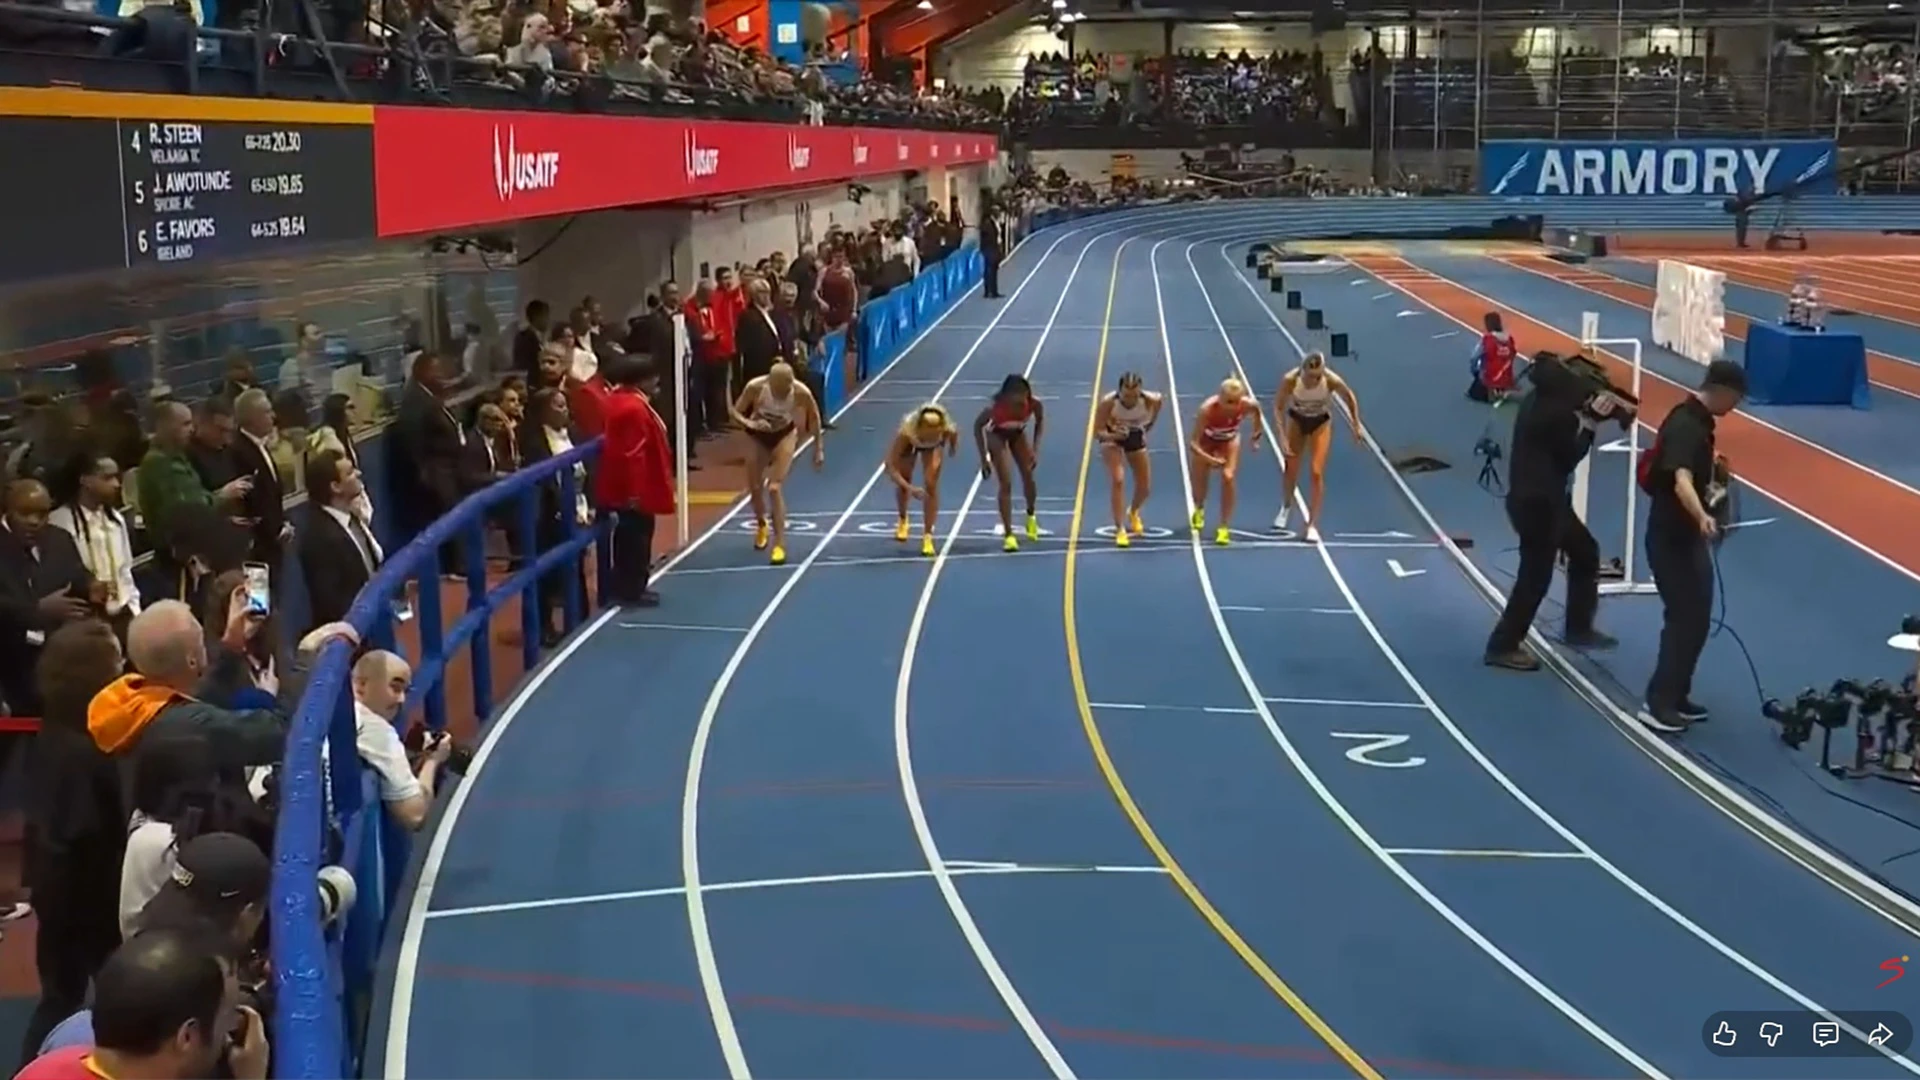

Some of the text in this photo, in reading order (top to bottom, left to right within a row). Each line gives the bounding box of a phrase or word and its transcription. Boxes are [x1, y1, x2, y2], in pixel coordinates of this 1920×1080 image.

[131, 123, 202, 154] 4 R. STEEN
[272, 131, 301, 151] 20.30
[278, 174, 303, 194] 19.85
[515, 152, 559, 190] USATF
[1536, 148, 1781, 195] ARMORY
[135, 171, 232, 204] 5 J. AWOTUNDE
[138, 218, 215, 253] 6 E. FAVORS
[278, 216, 305, 237] 19.64
[157, 244, 193, 261] IRELAND
[1329, 731, 1427, 768] 2
